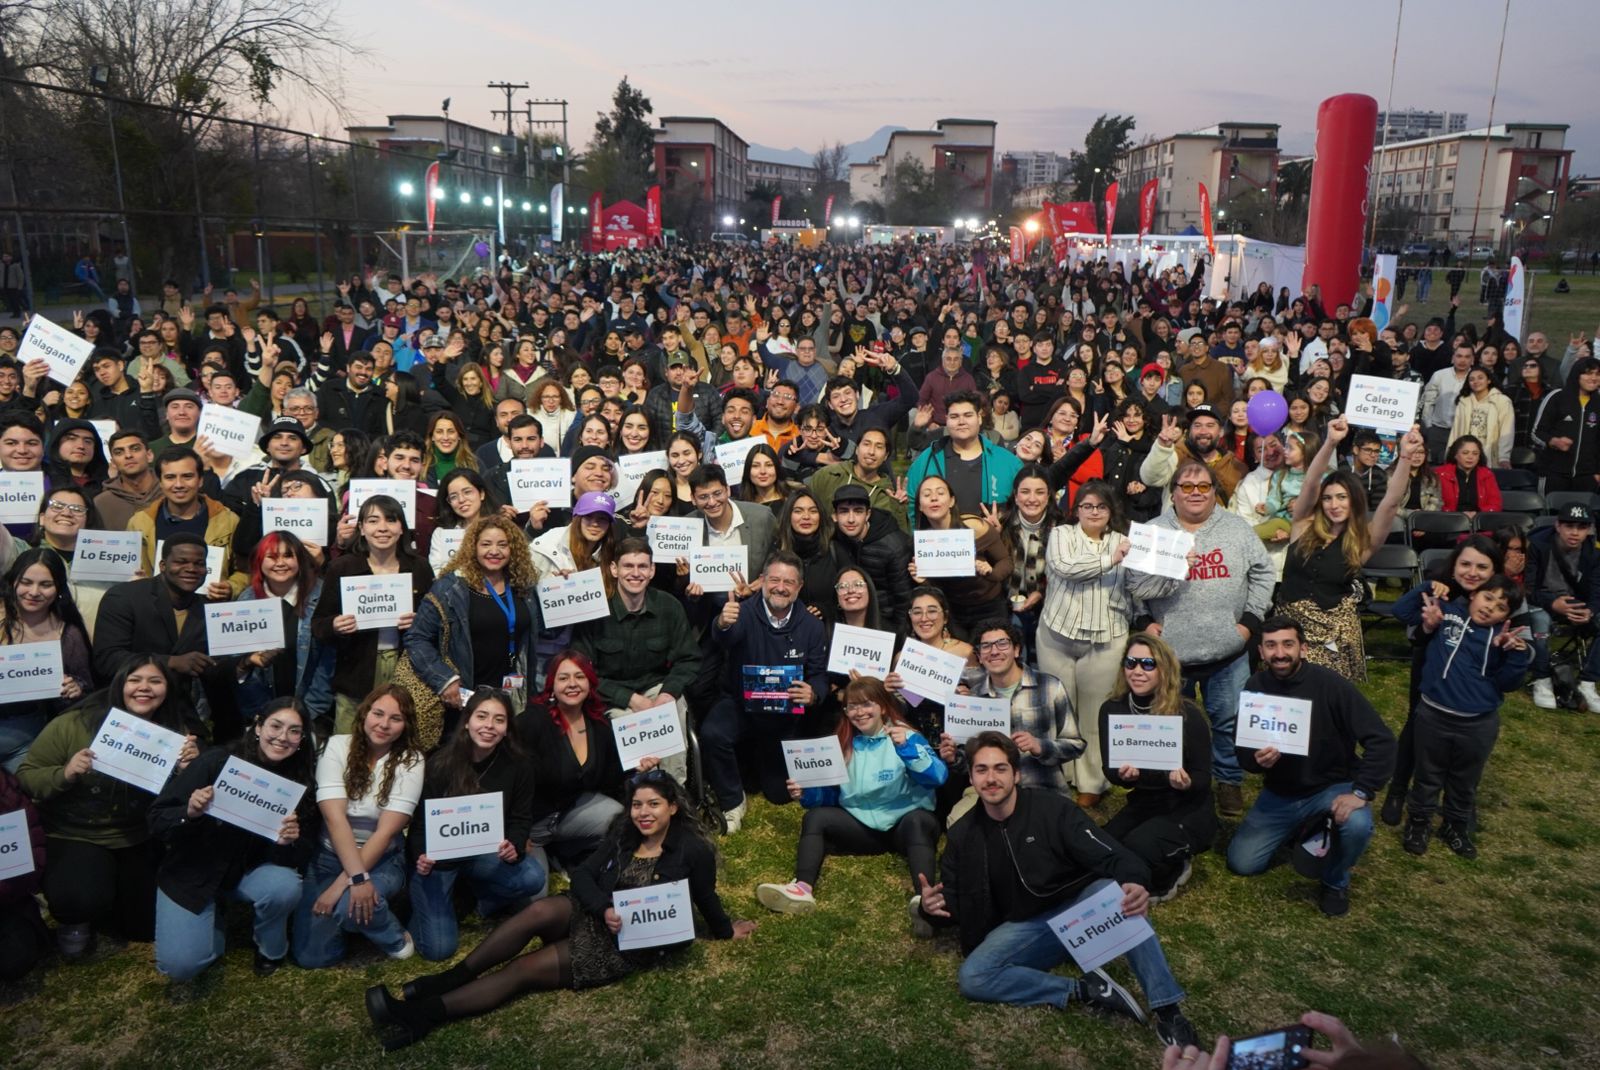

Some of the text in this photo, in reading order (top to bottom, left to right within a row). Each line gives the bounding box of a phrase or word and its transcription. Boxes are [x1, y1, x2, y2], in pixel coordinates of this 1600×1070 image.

[28, 334, 76, 367] Talagante
[1365, 393, 1399, 405] Calera
[1355, 404, 1404, 419] de Tango
[204, 422, 245, 442] Pirque
[722, 460, 736, 470] San
[517, 477, 563, 489] Curacaví
[275, 516, 313, 527] Renca
[656, 532, 692, 542] Estación
[657, 542, 689, 551] Central
[80, 550, 138, 564] Lo Espejo
[917, 549, 970, 560] San Joaquín
[695, 562, 742, 574] Conchalí
[358, 593, 395, 605] Quinta
[543, 589, 602, 609] San Pedro
[357, 602, 397, 615] Normal
[221, 618, 268, 634] Maipú
[842, 645, 881, 662] Macul
[7, 667, 53, 679] Condes
[900, 658, 953, 685] María Pinto
[947, 714, 1005, 727] Huechuraba
[1249, 714, 1298, 734] Paine
[621, 723, 674, 747] Lo Prado
[1112, 737, 1177, 748] Lo Barnechea
[100, 733, 167, 768] San Ramón
[794, 757, 832, 771] Ñuñoa
[216, 779, 288, 815] Providencia
[439, 821, 490, 838] Colina
[630, 904, 677, 925] Alhué
[1068, 935, 1086, 949] La
